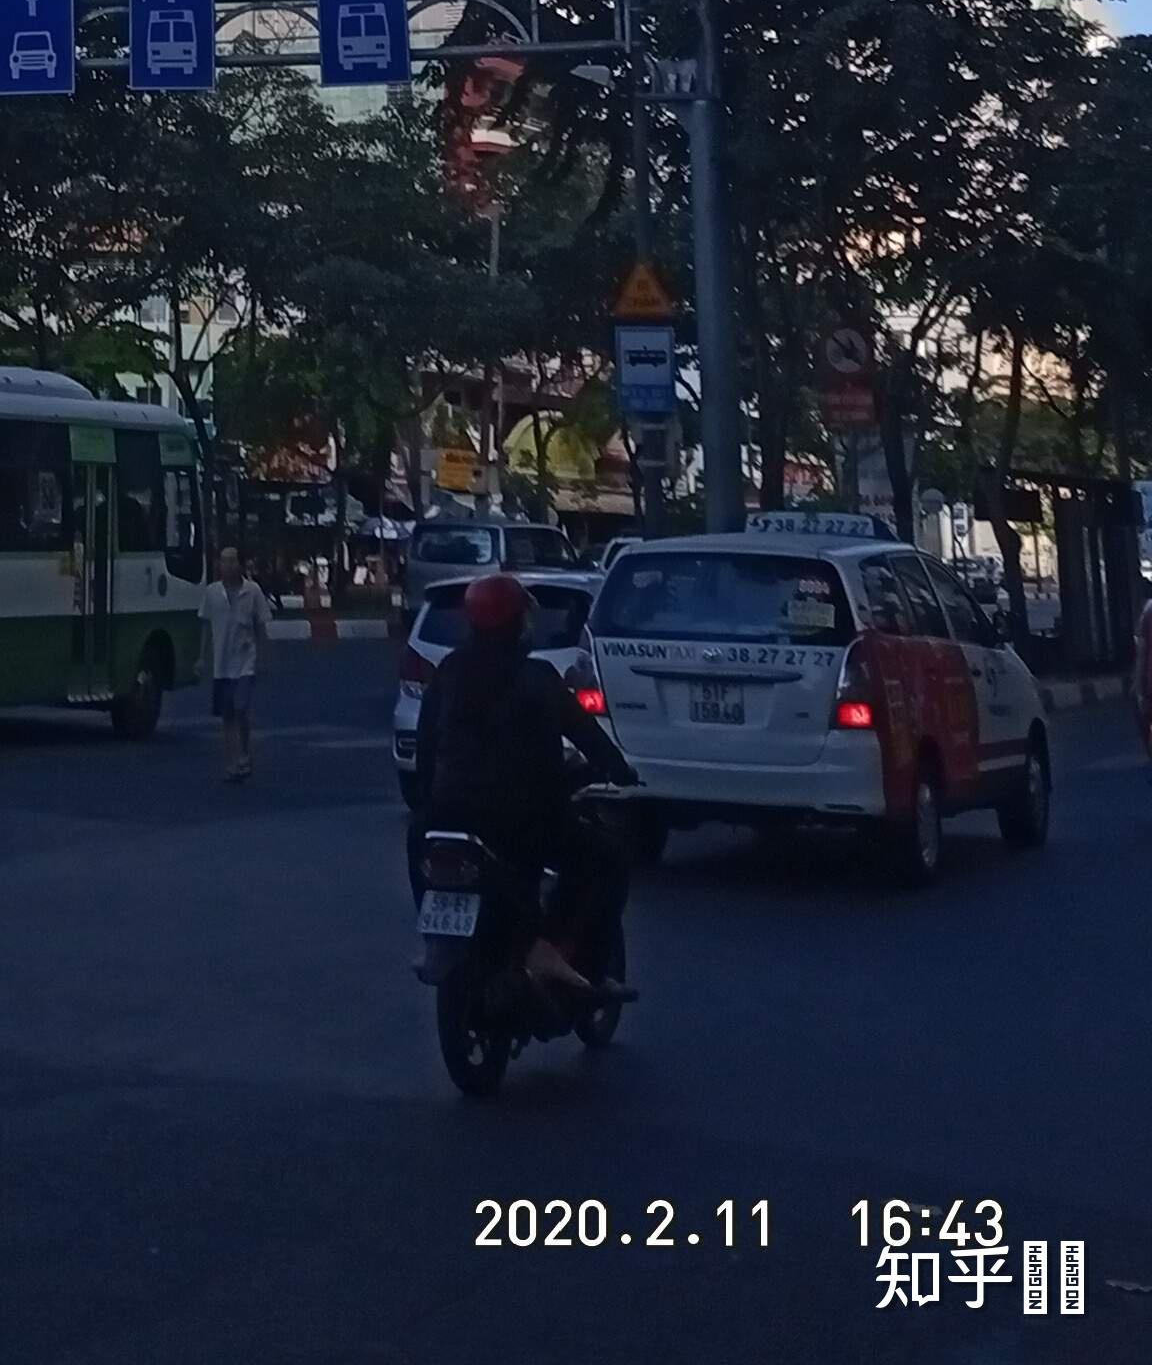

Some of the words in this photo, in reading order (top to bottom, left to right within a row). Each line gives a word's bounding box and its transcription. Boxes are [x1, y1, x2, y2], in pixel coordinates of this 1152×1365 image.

[602, 642, 666, 659] VINASUN
[785, 650, 806, 665] 27
[813, 651, 835, 667] 27
